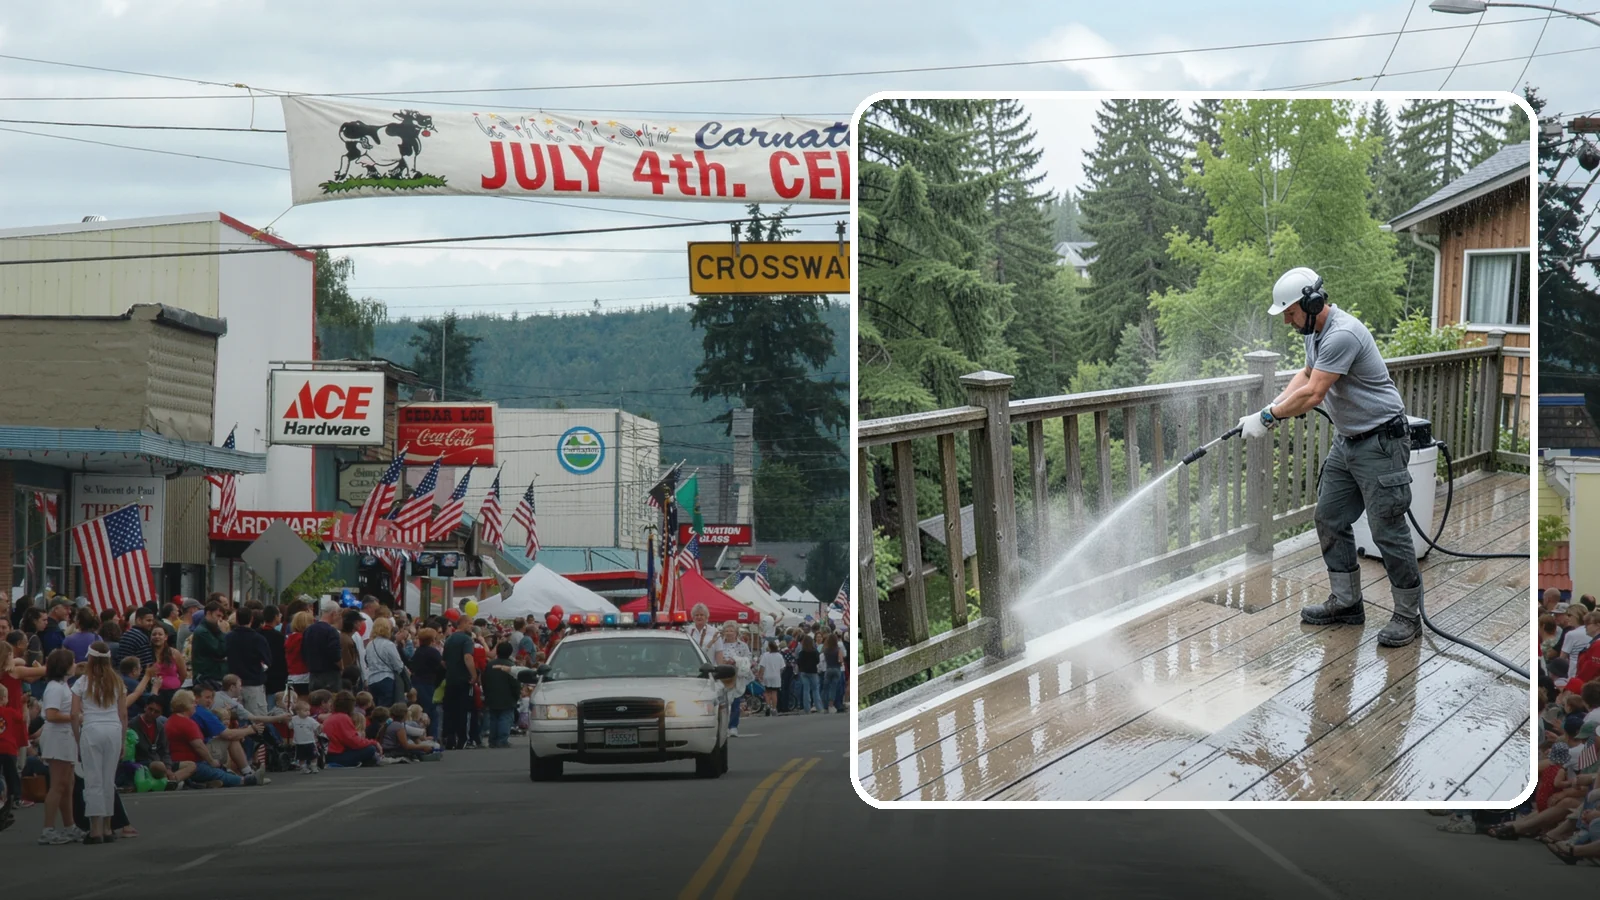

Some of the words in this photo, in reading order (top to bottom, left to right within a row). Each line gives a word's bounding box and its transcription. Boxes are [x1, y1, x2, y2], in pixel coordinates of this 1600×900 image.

[481, 141, 605, 192] JULY
[632, 149, 746, 198] 4th.
[696, 254, 850, 280] CROSSWA
[282, 380, 373, 420] ACE
[406, 410, 452, 421] CEDAR
[461, 410, 485, 421] LOG
[283, 421, 371, 436] Hardware
[416, 428, 477, 447] Coca-Cola
[95, 484, 124, 495] Vincent
[126, 486, 136, 495] de
[138, 485, 155, 495] Paul
[688, 526, 741, 535] CRNATION
[699, 535, 730, 543] GLASS
